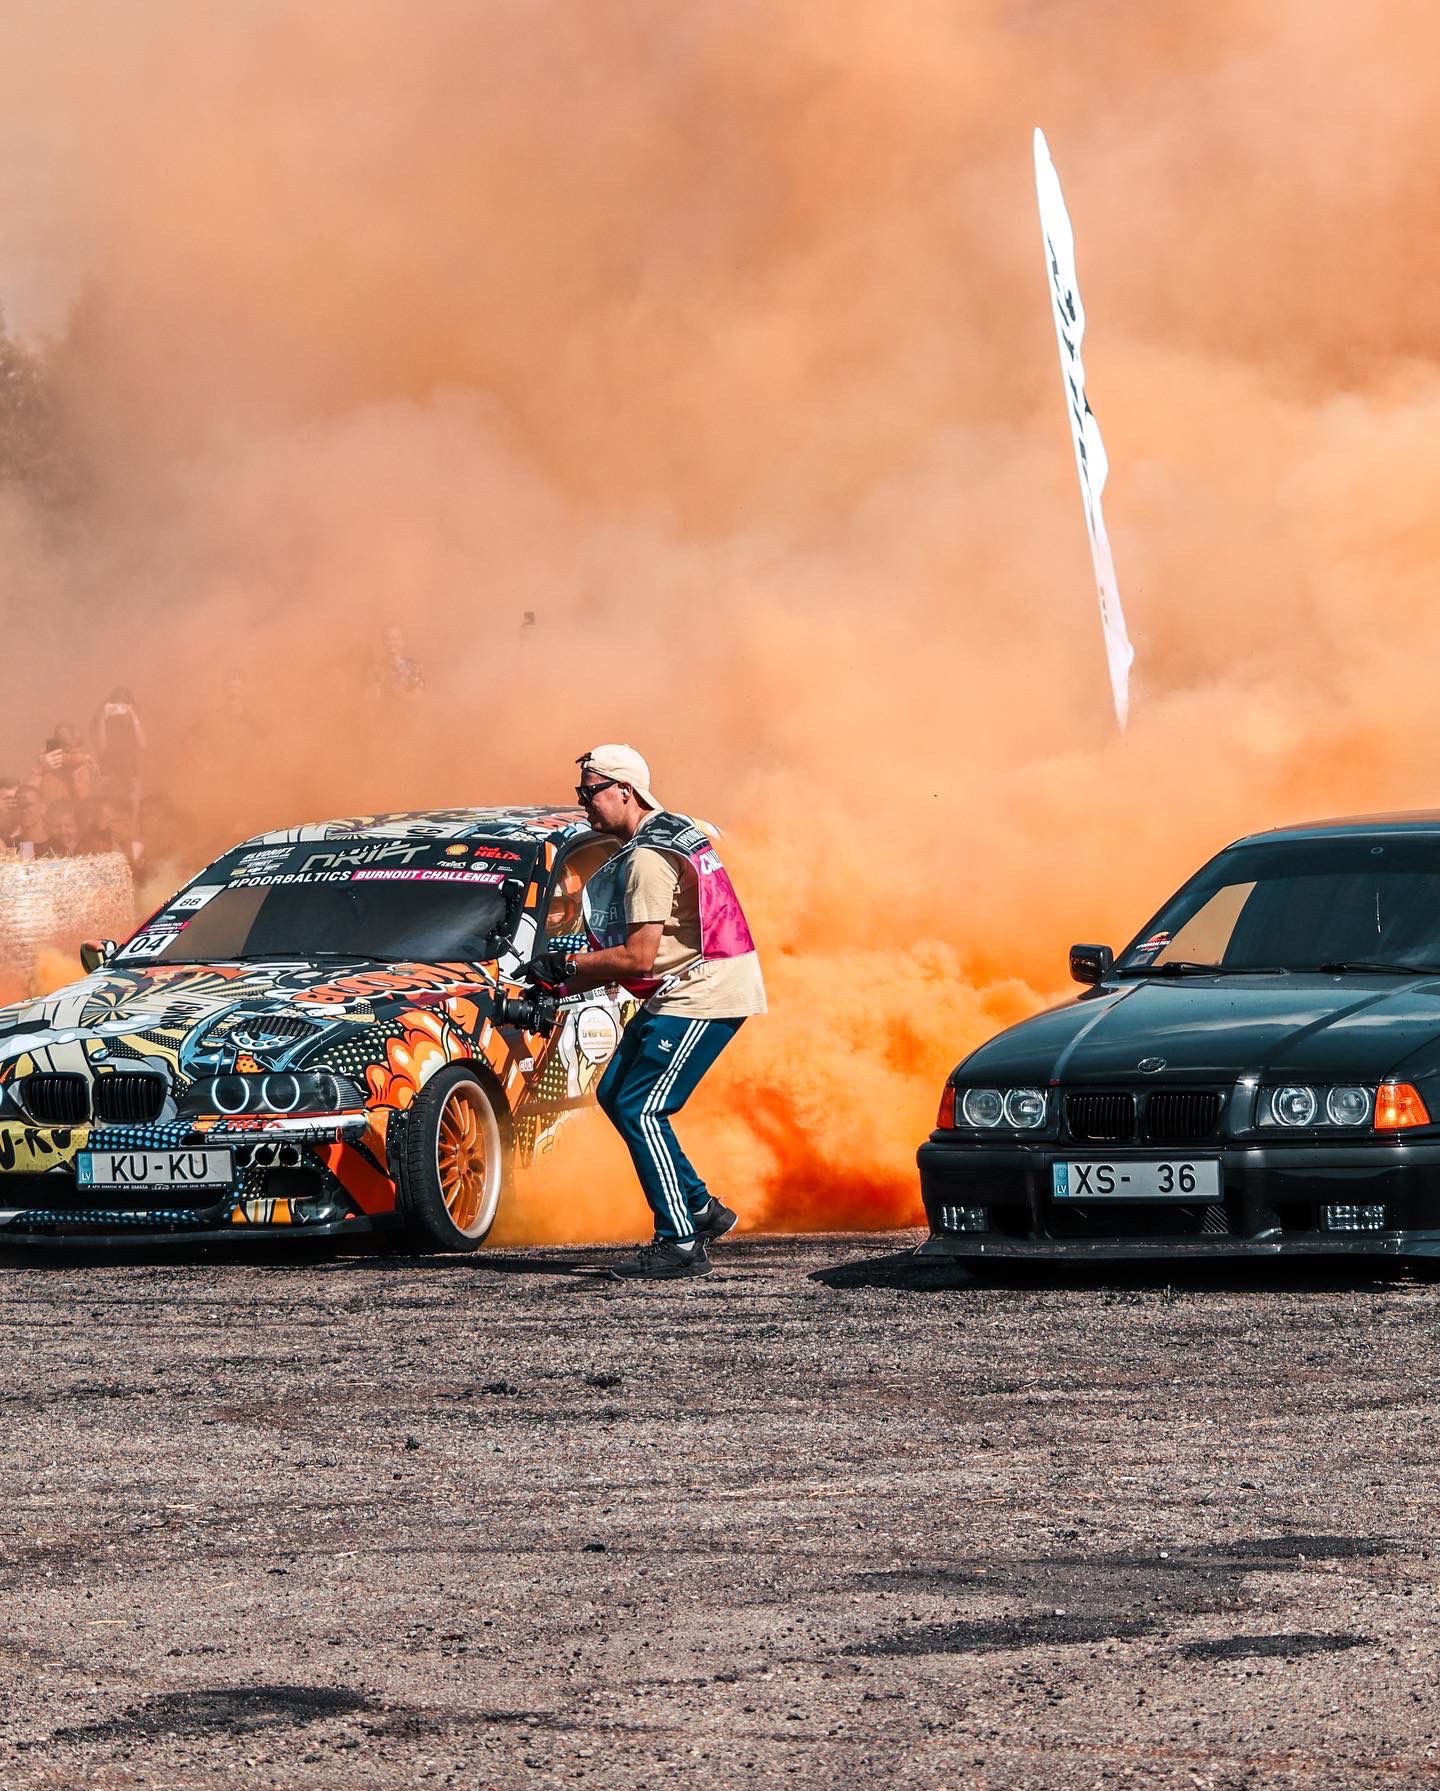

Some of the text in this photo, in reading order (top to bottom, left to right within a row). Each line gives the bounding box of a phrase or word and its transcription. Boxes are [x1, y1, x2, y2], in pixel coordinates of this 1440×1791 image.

[473, 850, 522, 861] HELIX
[227, 870, 352, 889] #POORBALTICS
[356, 870, 421, 880] BURNOUT
[421, 870, 501, 883] CHALLENGE
[128, 935, 169, 954] 04
[81, 1172, 92, 1181] LV
[110, 1152, 209, 1182] KU-KU
[1157, 1163, 1196, 1194] 36
[1056, 1185, 1067, 1194] LV
